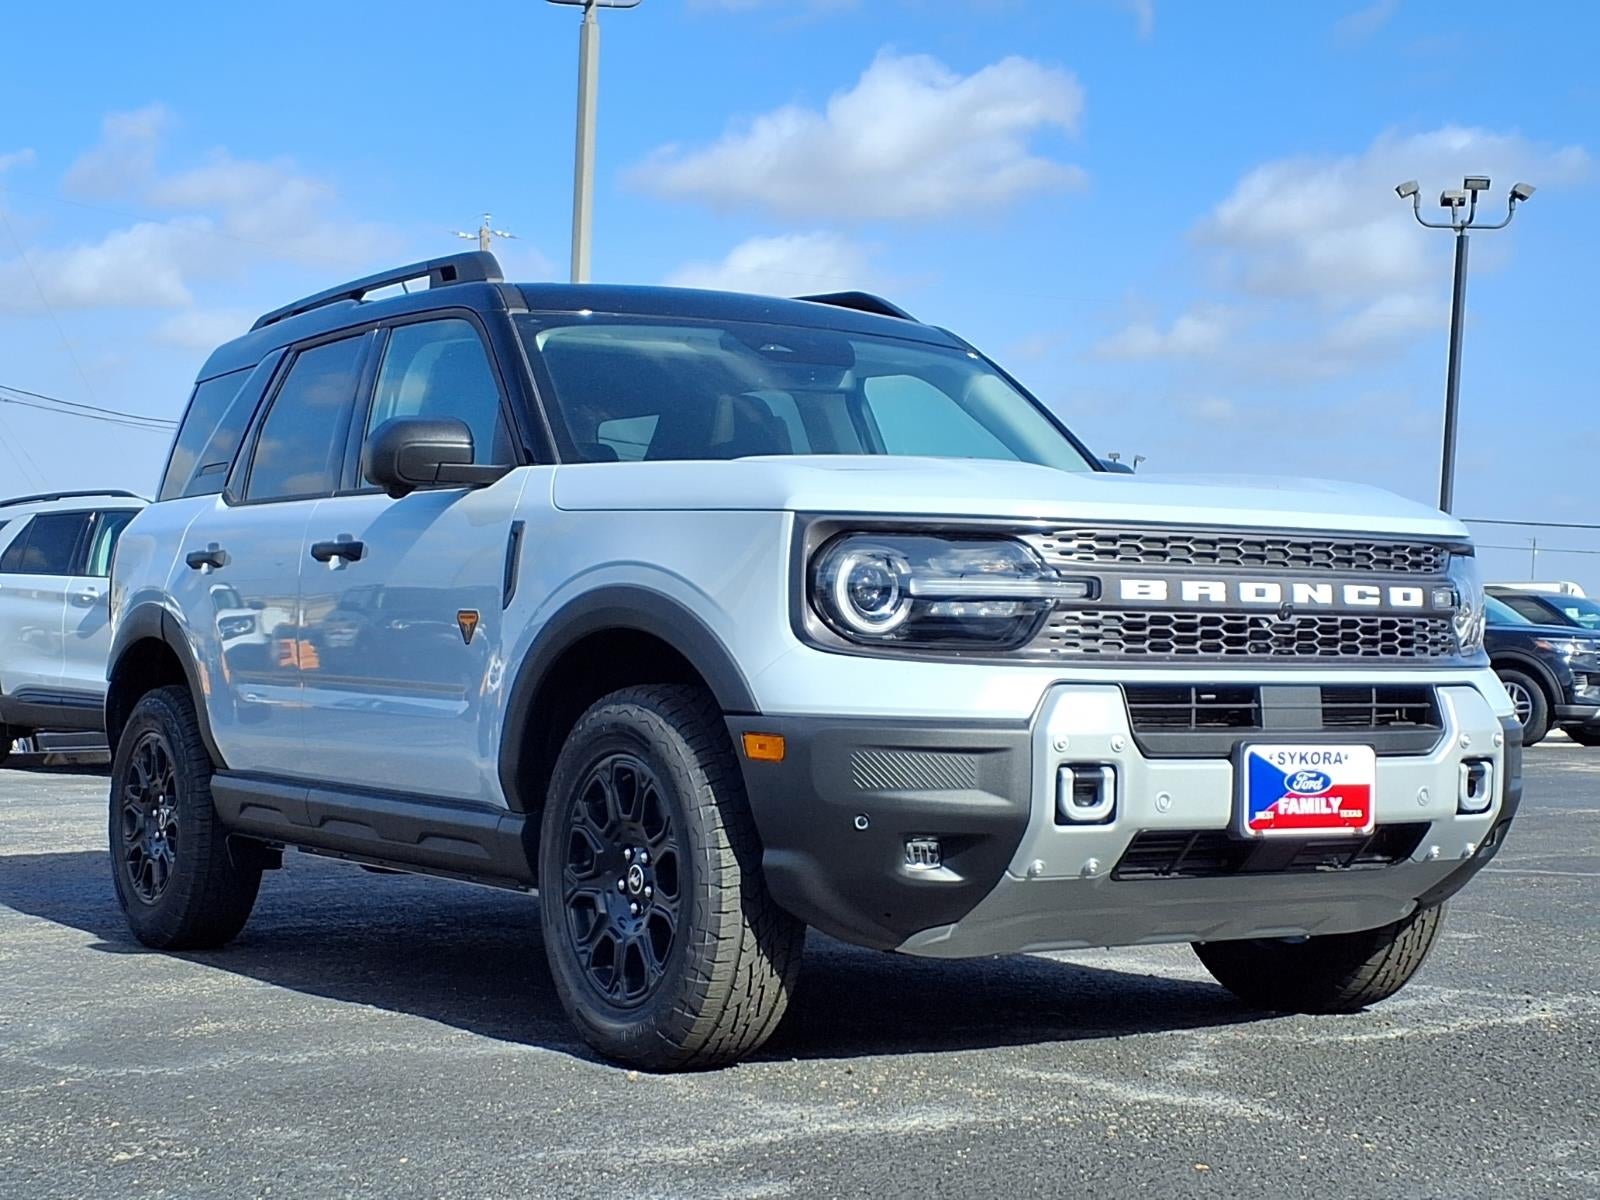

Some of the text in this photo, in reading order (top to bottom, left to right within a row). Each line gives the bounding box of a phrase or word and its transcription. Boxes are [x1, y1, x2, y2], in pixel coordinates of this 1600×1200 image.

[1120, 579, 1423, 607] BRONCO
[1277, 751, 1343, 765] SYKORA
[1292, 771, 1324, 791] Ford
[1278, 796, 1343, 815] FAMILY
